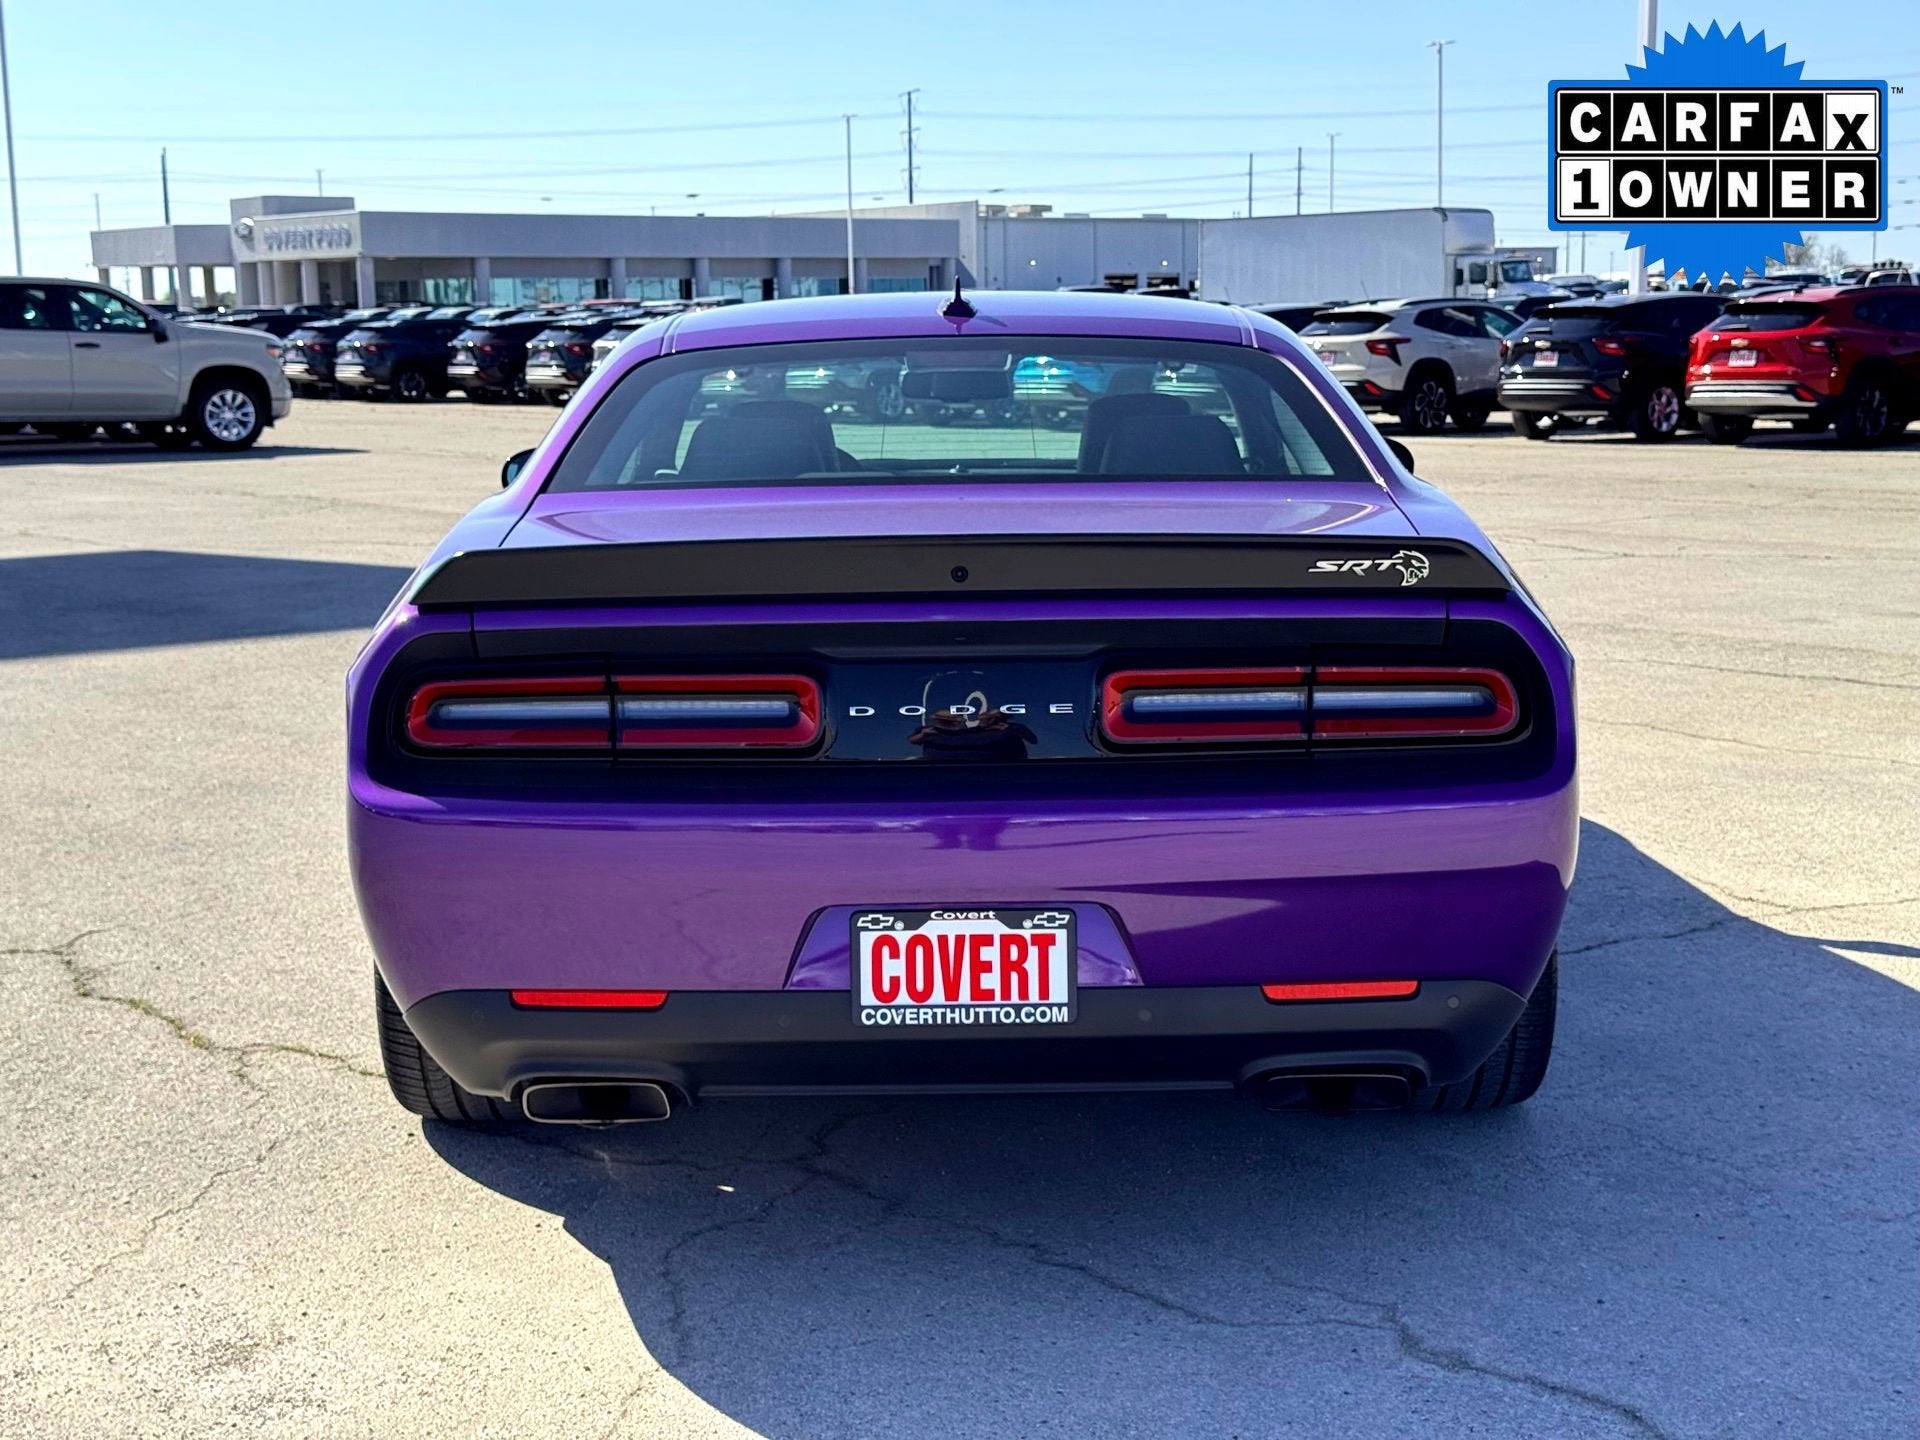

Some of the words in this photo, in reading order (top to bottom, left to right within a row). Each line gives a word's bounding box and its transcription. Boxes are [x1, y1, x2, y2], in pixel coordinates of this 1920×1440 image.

[1308, 559, 1403, 577] SRT
[849, 704, 1074, 716] DODGE
[931, 910, 996, 920] Covert
[871, 932, 1057, 1004] COVERT
[861, 1007, 1069, 1025] COVERTHUTTO.COM
